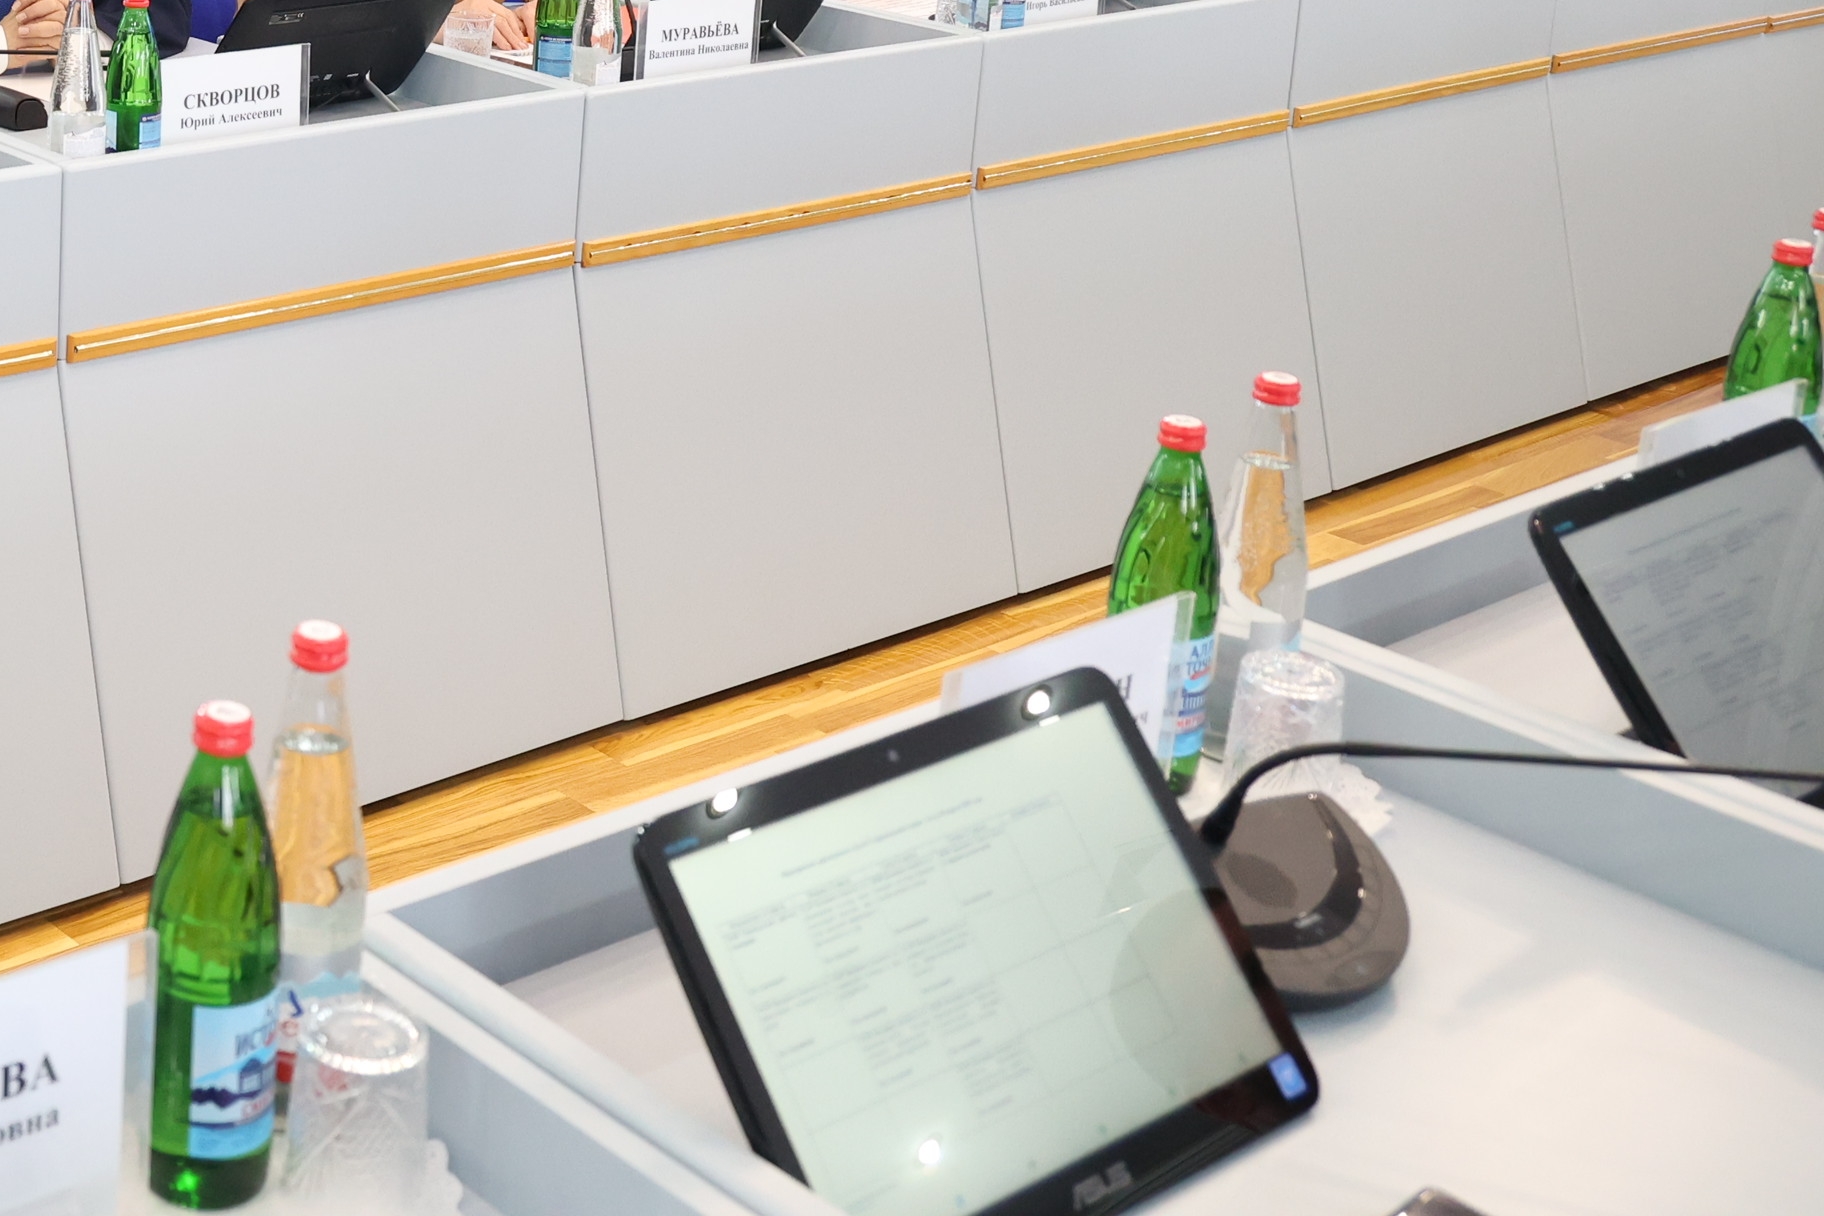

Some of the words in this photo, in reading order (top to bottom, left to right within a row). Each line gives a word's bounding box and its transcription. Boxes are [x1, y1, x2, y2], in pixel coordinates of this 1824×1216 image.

[661, 20, 740, 43] МУРАВЬЁВА
[649, 46, 696, 60] Валентина
[697, 41, 749, 55] Николаевна
[183, 83, 280, 110] СКВОРЦОВ
[180, 114, 215, 130] Юрий
[218, 107, 283, 125] Алексеевич
